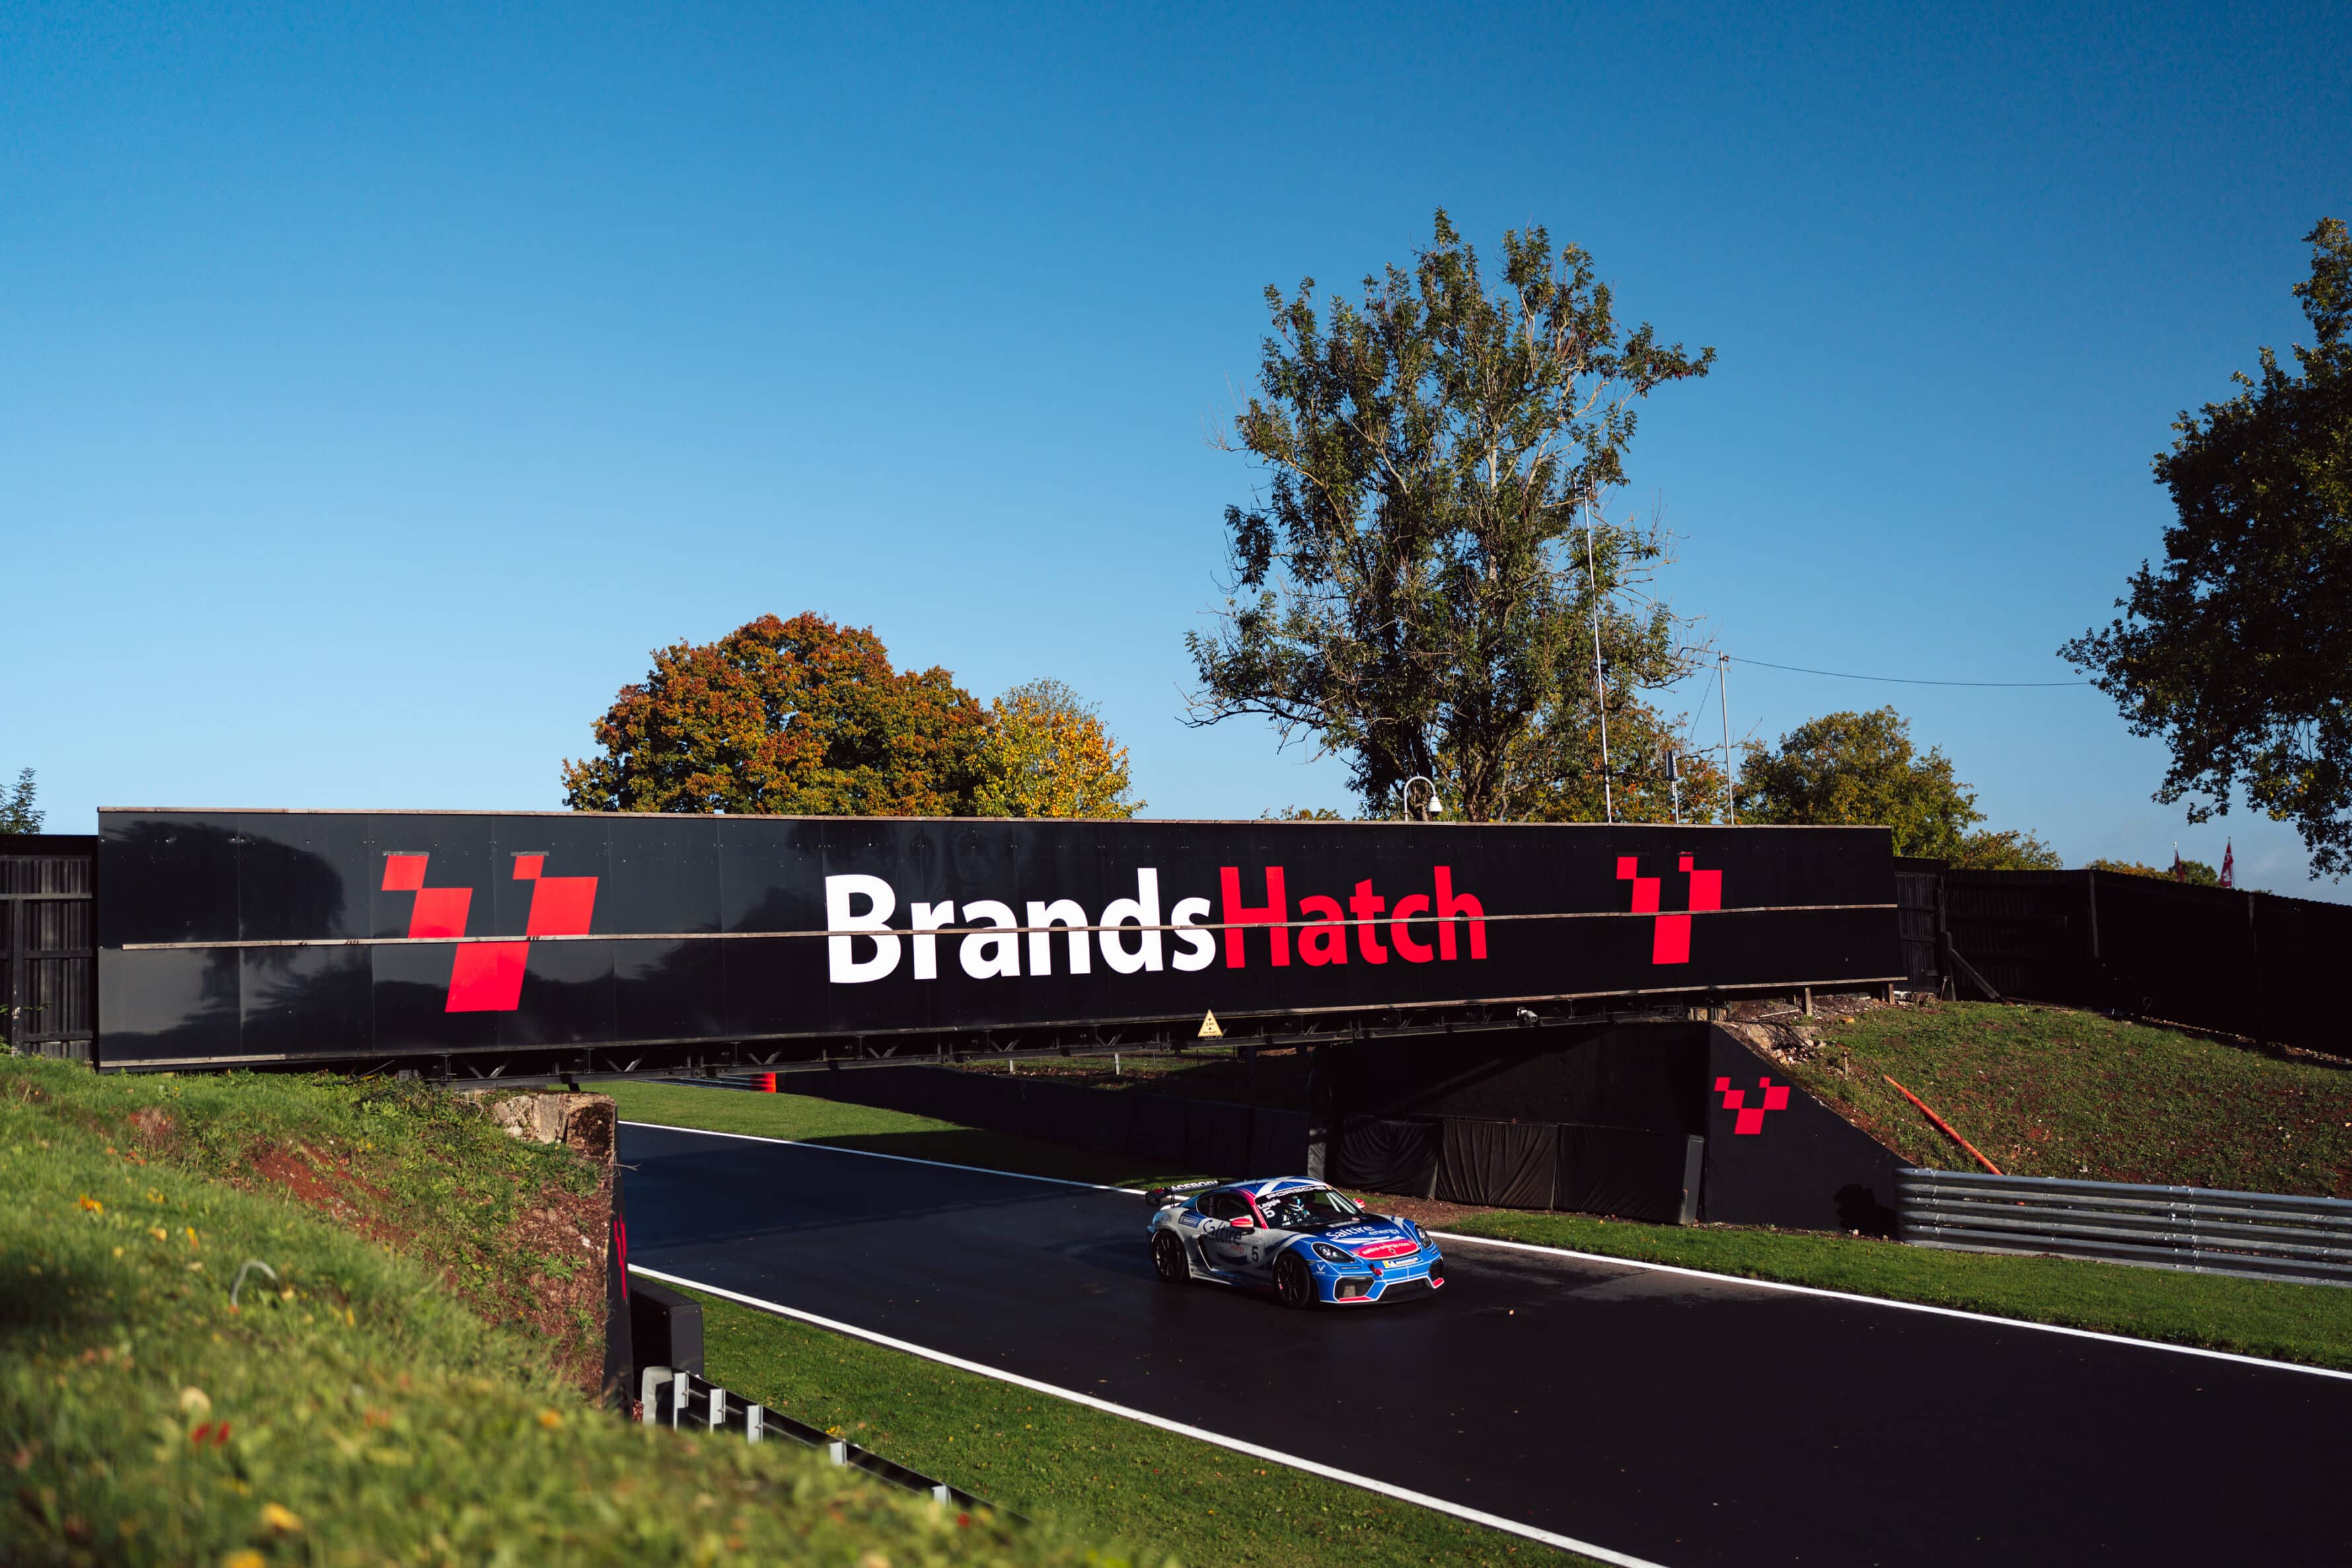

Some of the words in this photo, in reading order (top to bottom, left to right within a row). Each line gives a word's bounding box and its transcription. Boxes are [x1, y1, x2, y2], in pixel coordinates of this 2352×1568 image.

[1267, 1186, 1327, 1199] PORSCHE
[1257, 1199, 1280, 1209] Loggie
[1263, 1207, 1275, 1219] 5
[1325, 1226, 1375, 1239] Saltire
[1251, 1245, 1259, 1262] 5
